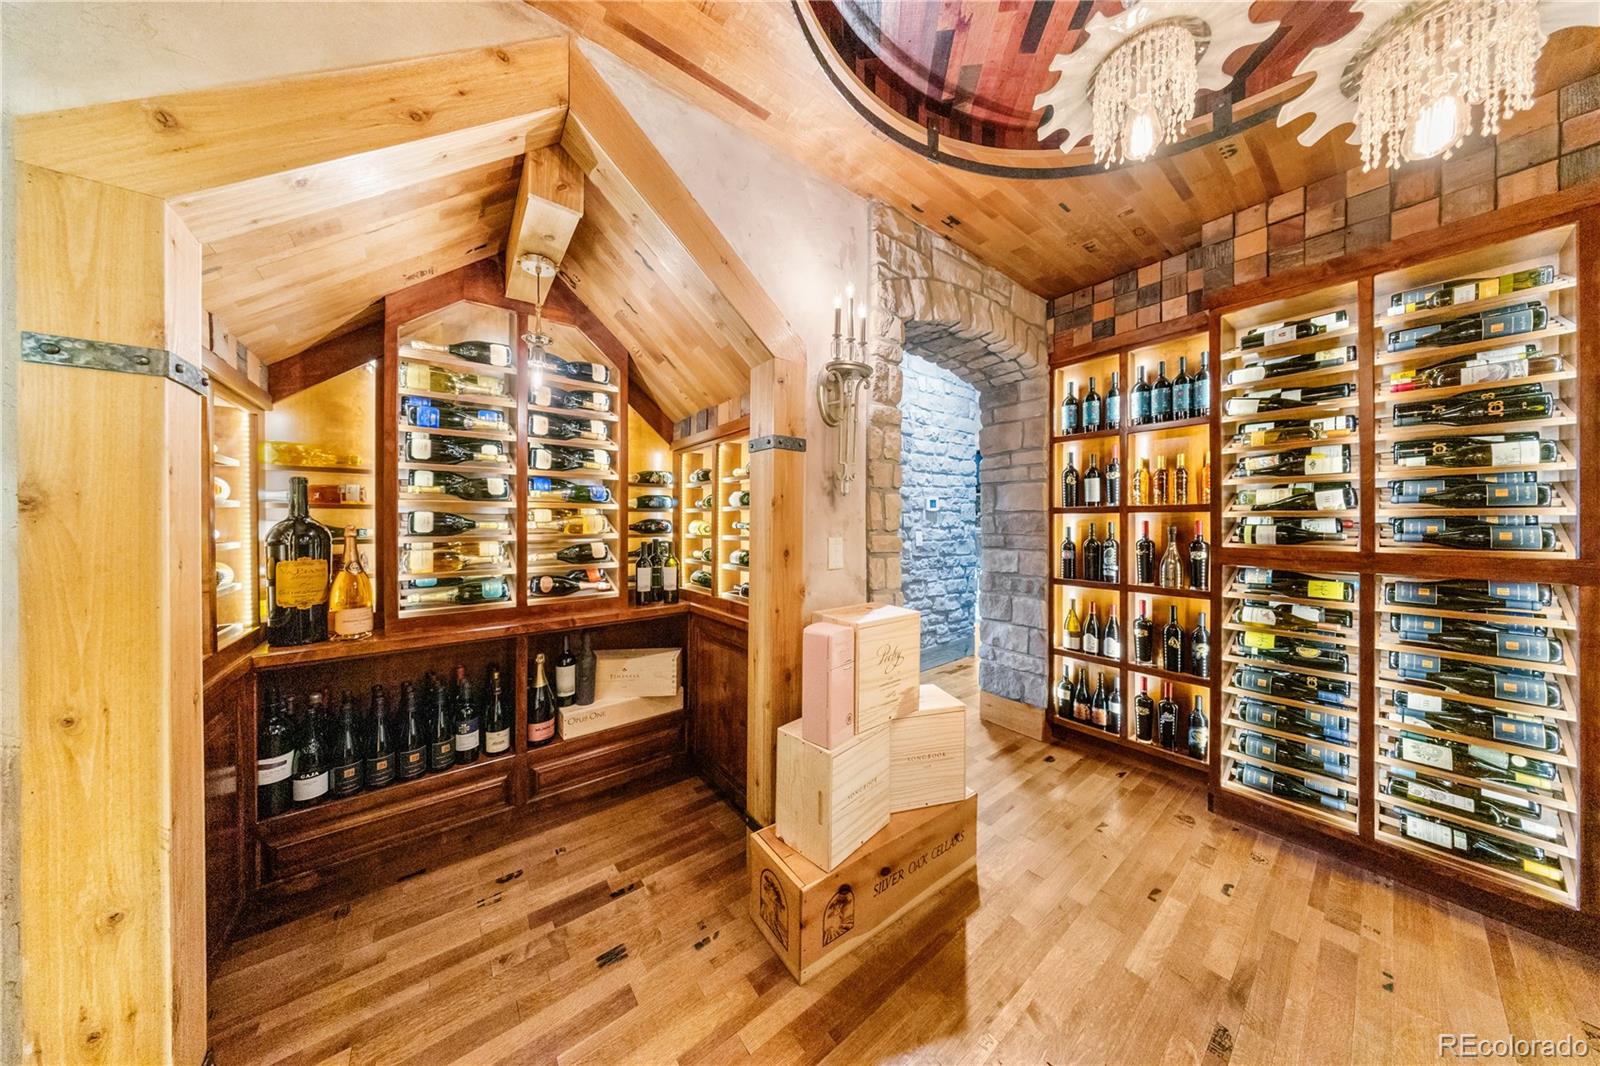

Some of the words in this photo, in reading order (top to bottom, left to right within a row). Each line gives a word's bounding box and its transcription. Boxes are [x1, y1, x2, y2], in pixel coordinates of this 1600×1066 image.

[873, 868, 904, 898] SILVER
[908, 852, 928, 874] OAK
[931, 830, 965, 859] CELLARS
